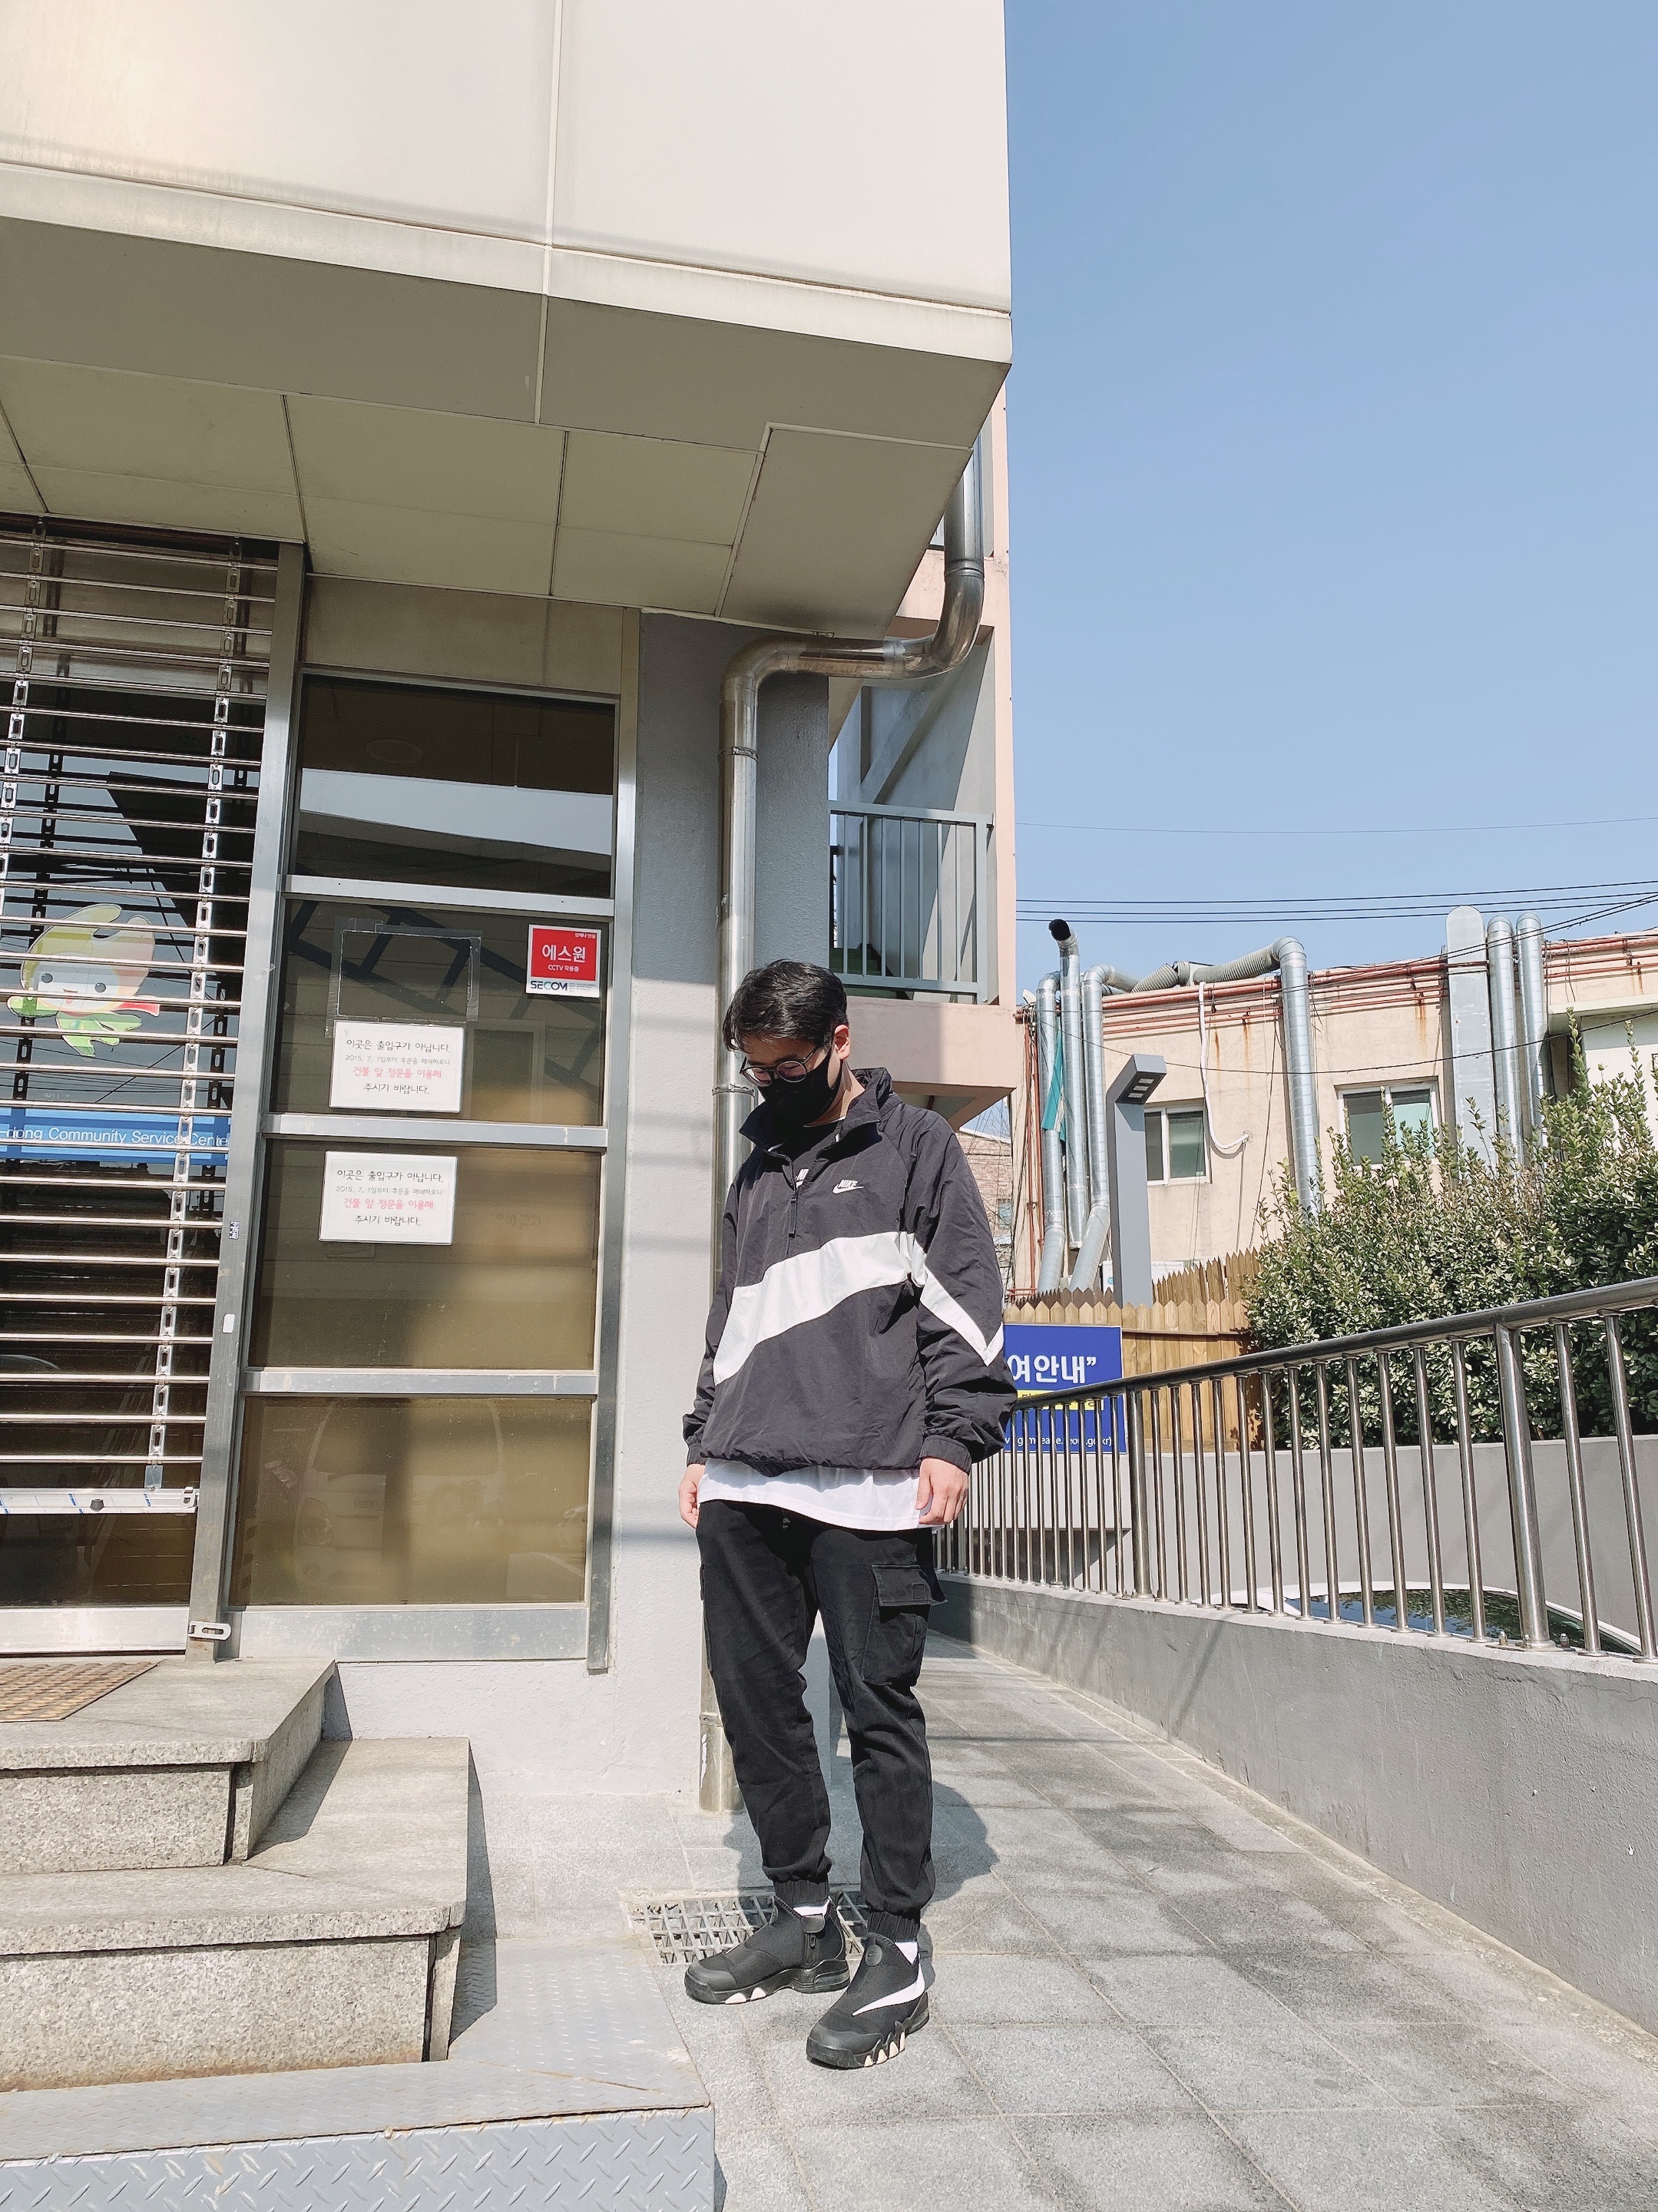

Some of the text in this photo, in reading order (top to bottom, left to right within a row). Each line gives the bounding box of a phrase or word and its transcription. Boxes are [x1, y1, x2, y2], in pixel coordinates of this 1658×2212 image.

[541, 944, 586, 962] 에스원
[530, 980, 568, 991] SECOM
[346, 1039, 451, 1053] 이곳은 출입구가 아닙니다.
[352, 1066, 442, 1080] 건물 앞 정문을 이용해
[363, 1083, 429, 1094] 주시기 바랍니다.
[48, 1127, 127, 1144] Community
[336, 1170, 444, 1183] 이곳은 출입구가 아닙니다.
[838, 1179, 859, 1188] NIKE
[343, 1197, 434, 1211] 건물 앞 정문을 이용해
[354, 1215, 421, 1227] 주시기 바랍니다.
